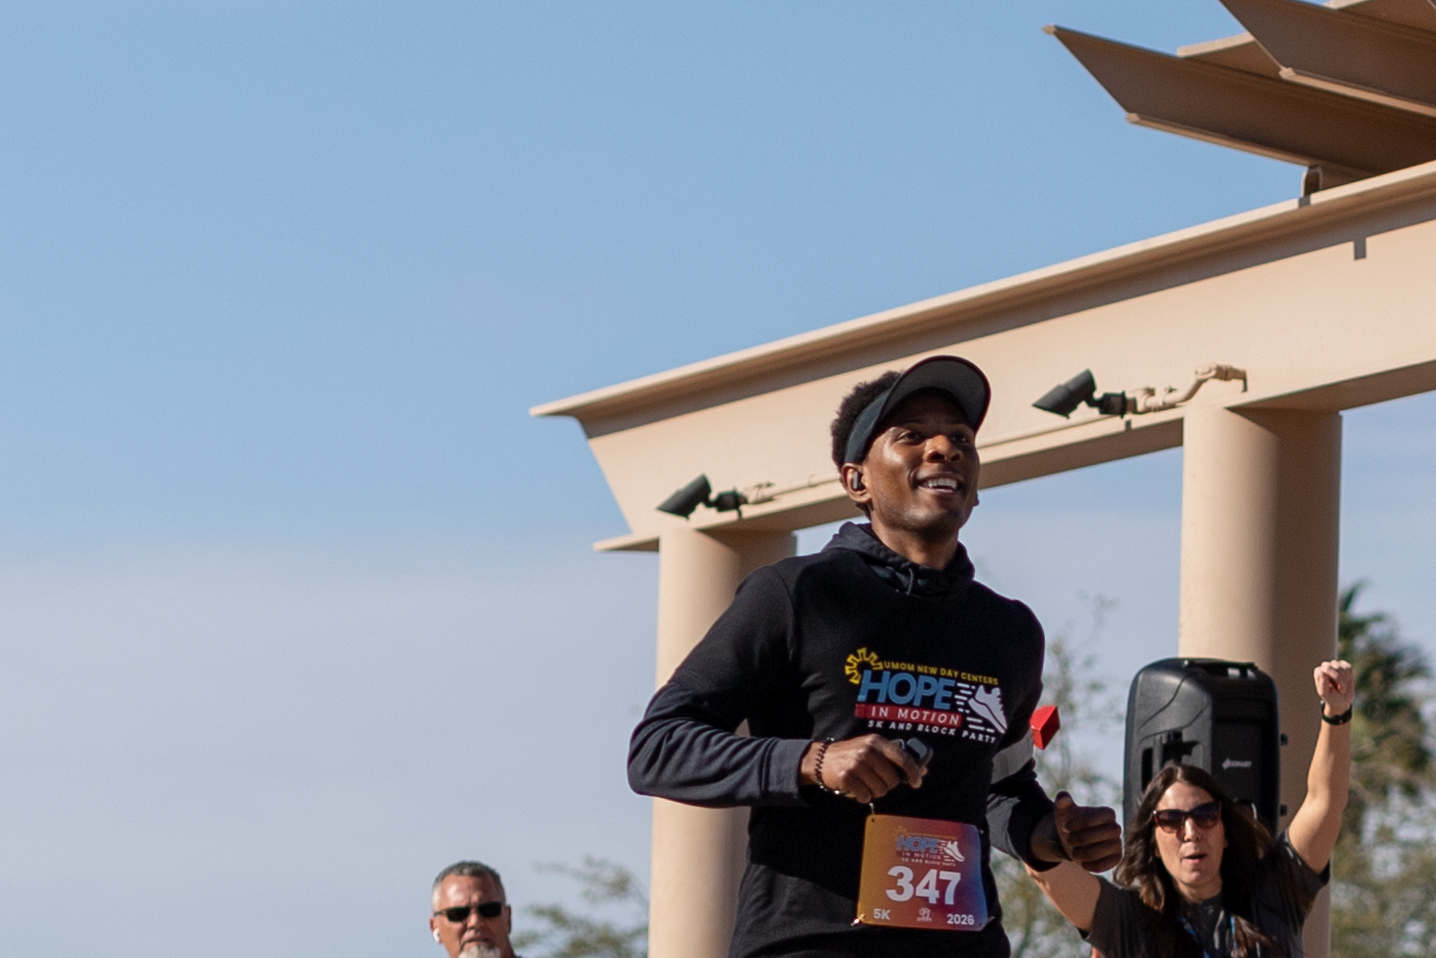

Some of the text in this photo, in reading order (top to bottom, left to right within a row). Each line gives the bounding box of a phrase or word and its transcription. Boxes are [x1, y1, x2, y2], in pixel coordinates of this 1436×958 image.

[884, 661, 999, 685] UMOM NEW DAY CENTERS
[857, 669, 956, 710] HOPE
[871, 706, 960, 725] IN MOTION
[889, 721, 913, 731] AND
[917, 724, 956, 736] BLOCK
[962, 730, 996, 744] PARTY
[896, 836, 940, 853] HOPE
[885, 865, 961, 905] 347
[873, 908, 890, 920] 5K
